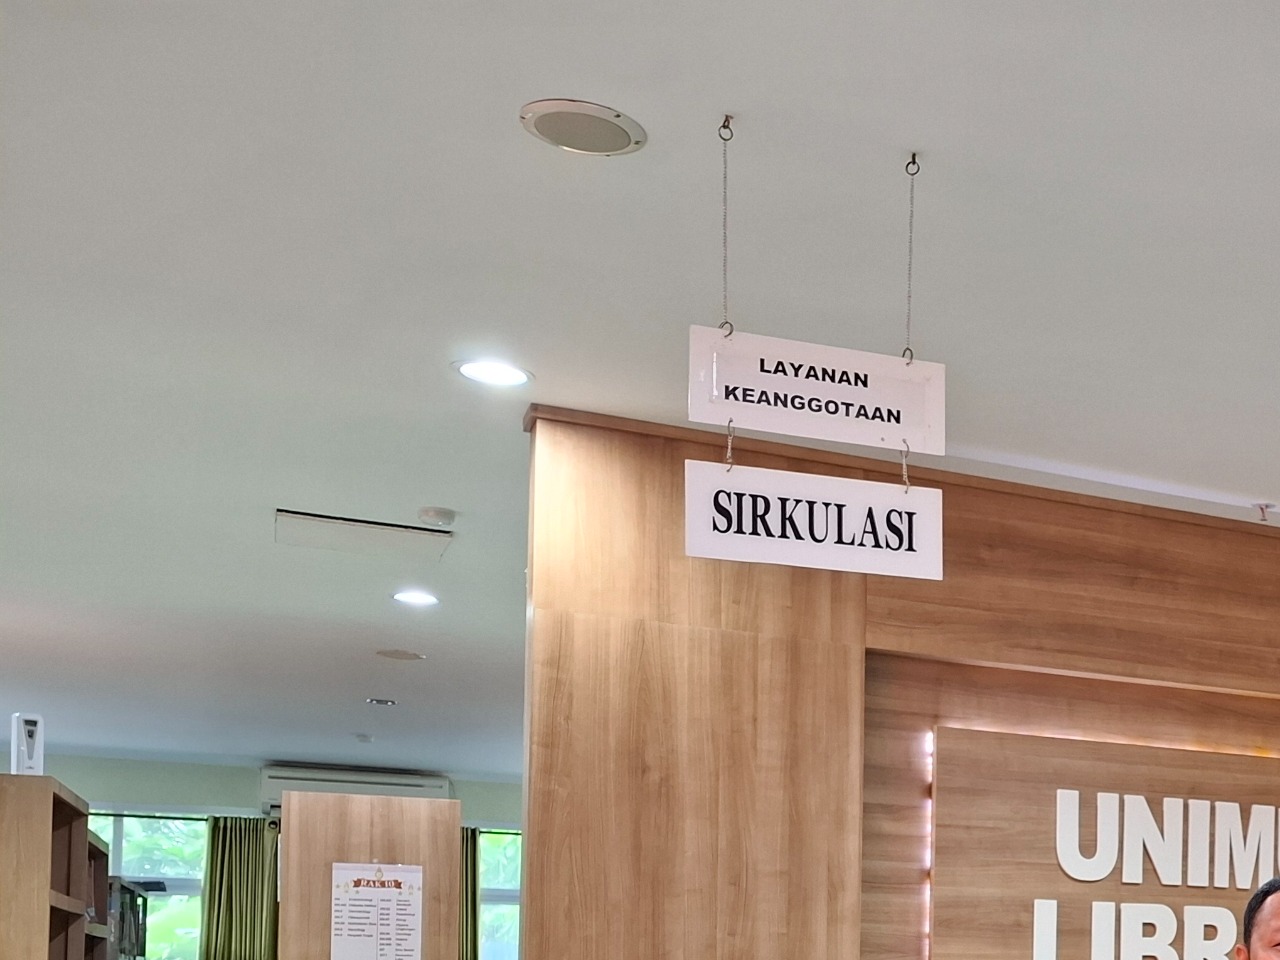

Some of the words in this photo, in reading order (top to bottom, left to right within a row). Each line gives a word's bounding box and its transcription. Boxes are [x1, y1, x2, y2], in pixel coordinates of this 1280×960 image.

[759, 358, 869, 388] LAYANAN
[724, 385, 902, 424] KEANGGOTAAN
[712, 489, 917, 552] SIRKULASI
[360, 879, 381, 888] RAK
